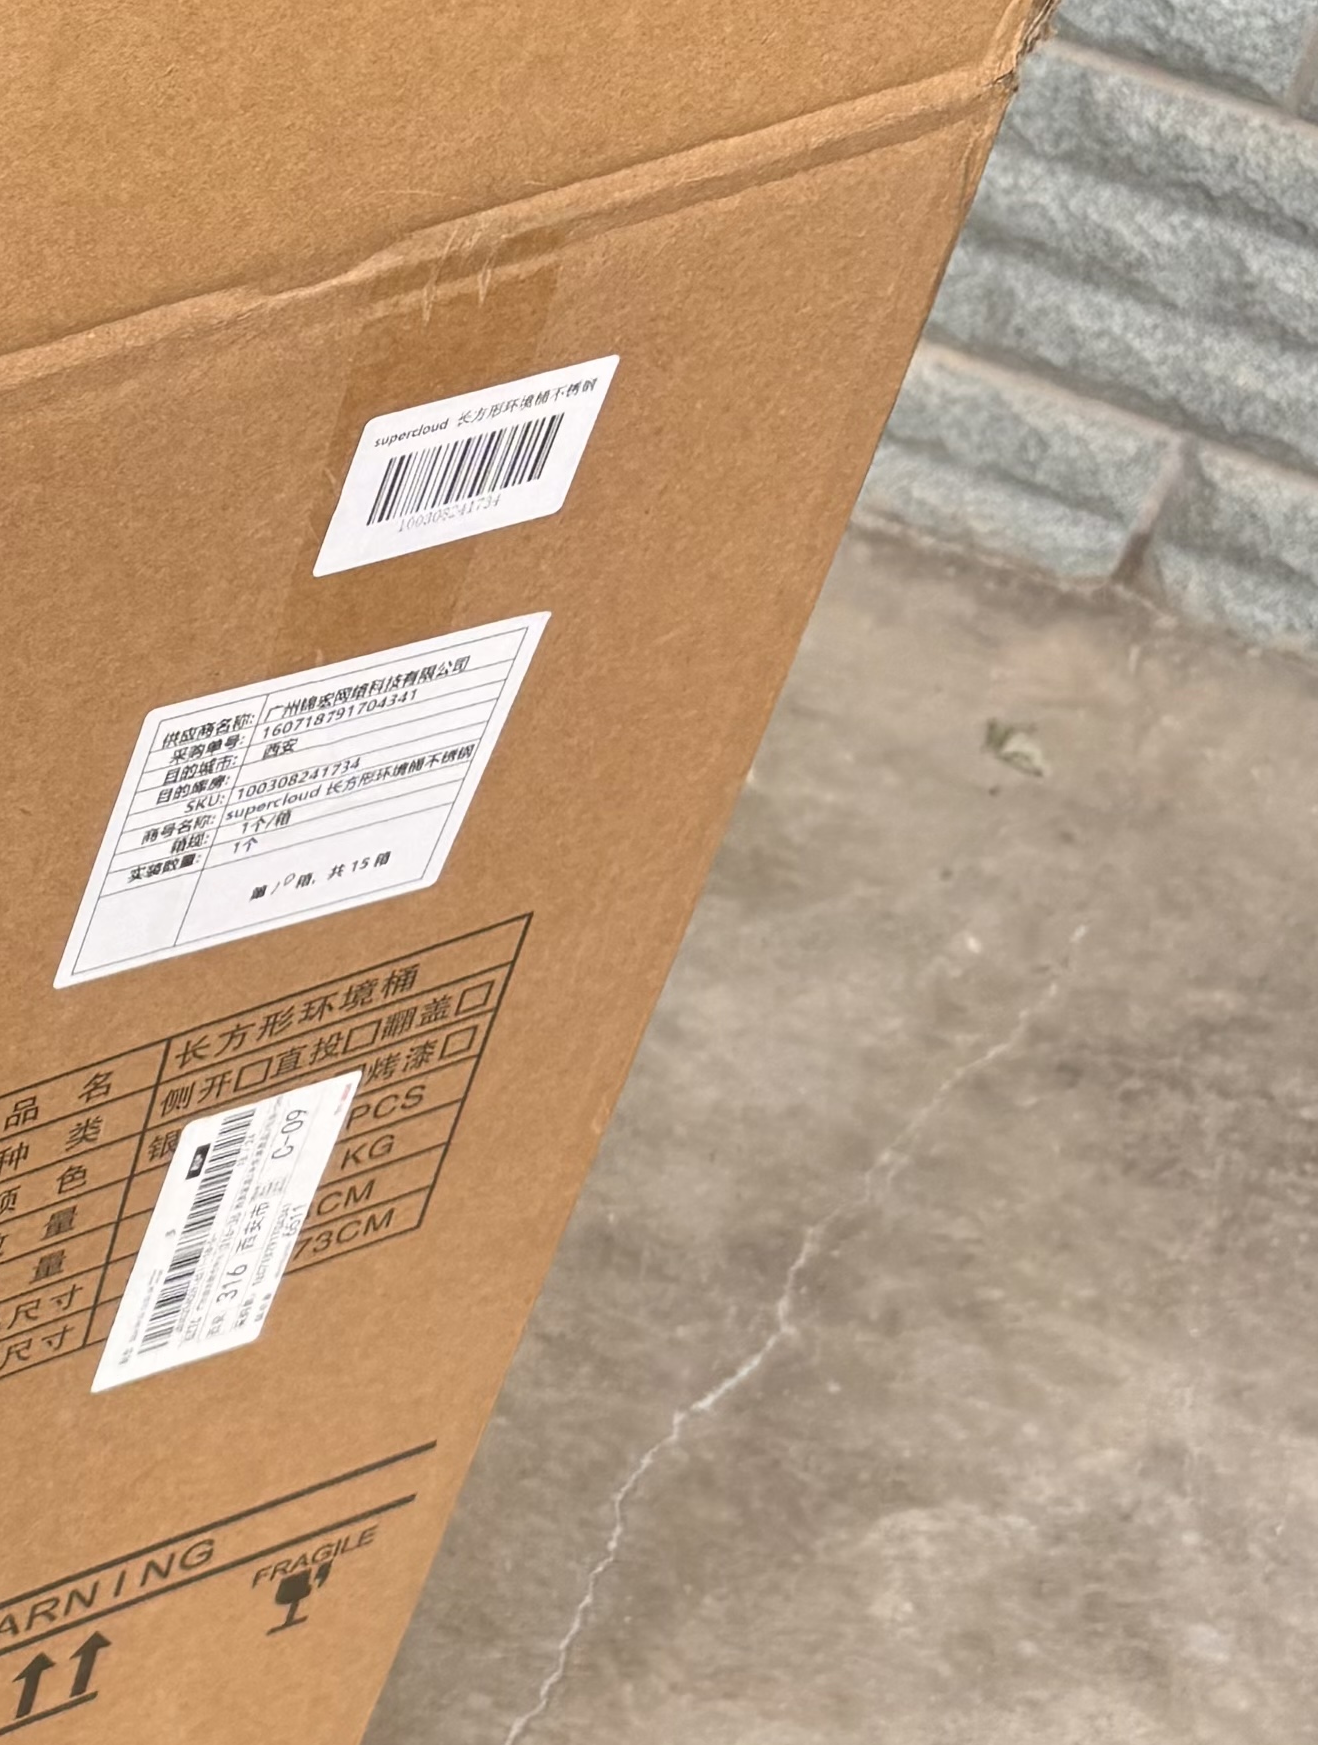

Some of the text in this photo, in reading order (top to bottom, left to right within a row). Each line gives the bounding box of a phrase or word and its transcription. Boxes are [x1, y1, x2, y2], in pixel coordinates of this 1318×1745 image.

[374, 418, 449, 448] supercloud
[236, 757, 362, 801] 100308241734
[225, 784, 321, 822] supercloud
[175, 962, 422, 1071] 长方形环境桶
[345, 1085, 428, 1131] PCS
[271, 1108, 309, 1160] C-09
[340, 1134, 397, 1172] KG
[306, 1178, 378, 1221] CM
[216, 1264, 248, 1304] 316
[235, 1201, 271, 1254] 西安市
[250, 1525, 379, 1589] FRAGILE
